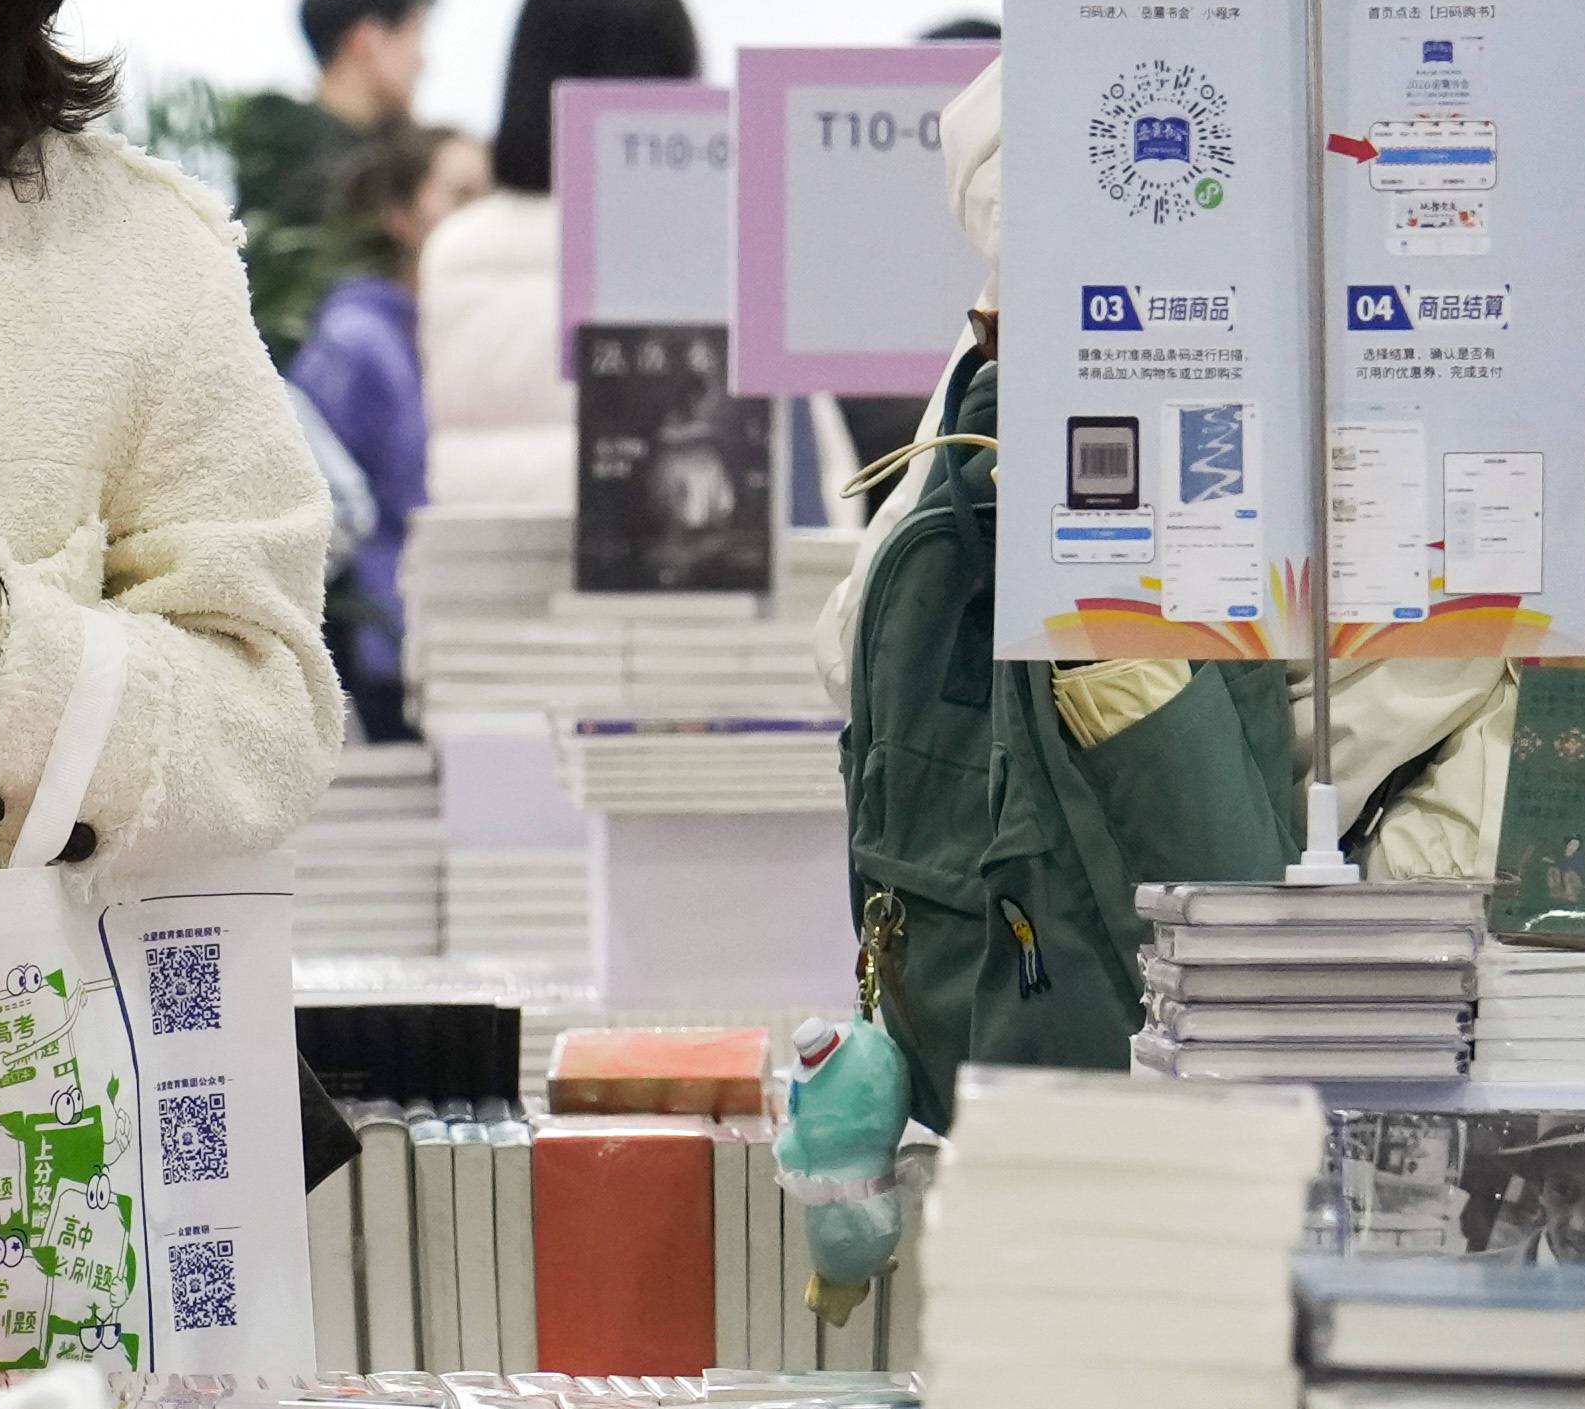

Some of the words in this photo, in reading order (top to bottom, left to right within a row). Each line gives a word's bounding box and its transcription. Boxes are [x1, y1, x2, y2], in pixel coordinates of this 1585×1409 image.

[1090, 294, 1125, 322] 03
[1148, 295, 1229, 321] 扫描商品
[1356, 294, 1395, 322] 04
[1418, 294, 1505, 320] 商品结算
[57, 1214, 94, 1251] 高中
